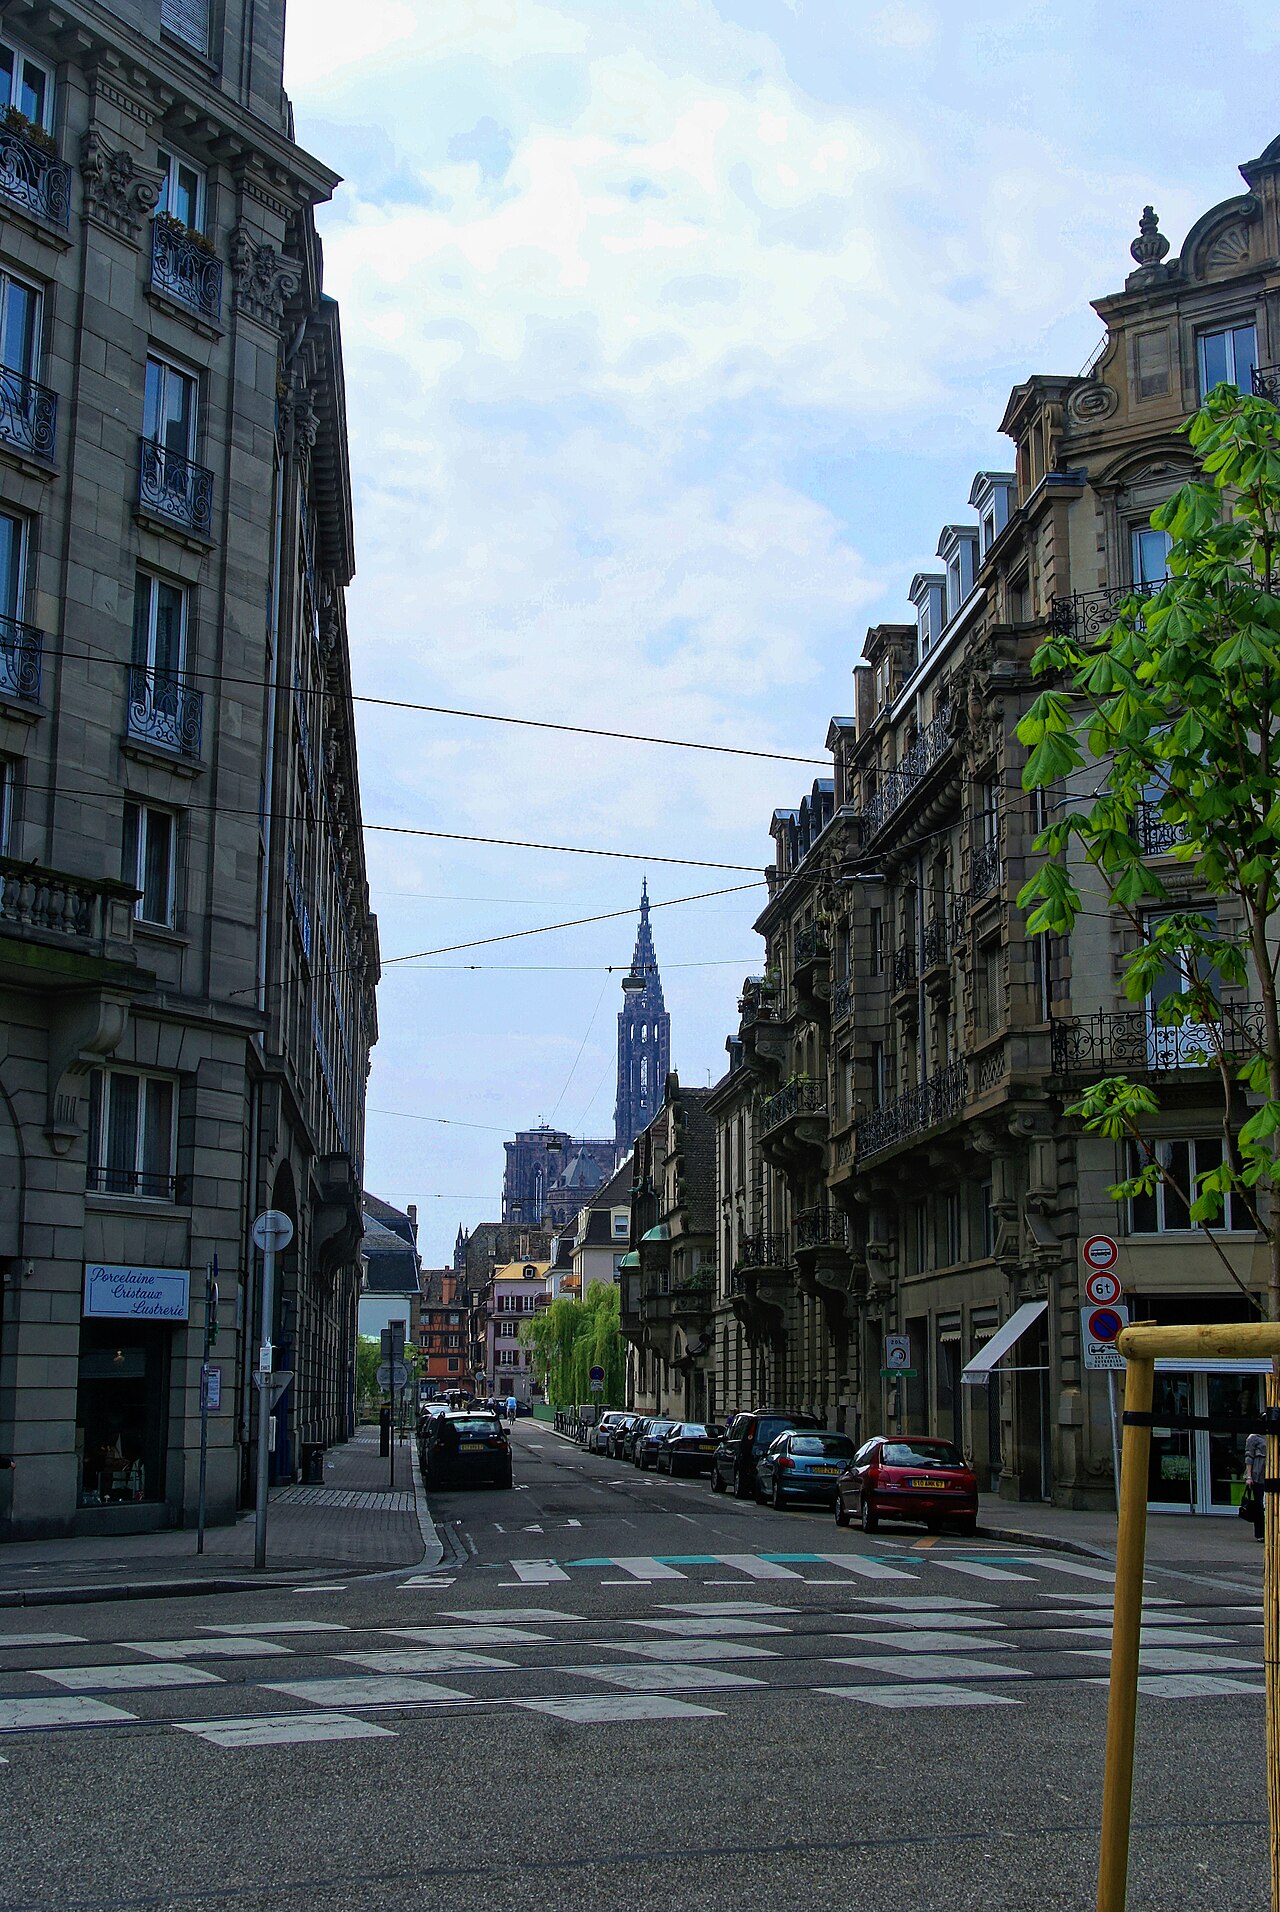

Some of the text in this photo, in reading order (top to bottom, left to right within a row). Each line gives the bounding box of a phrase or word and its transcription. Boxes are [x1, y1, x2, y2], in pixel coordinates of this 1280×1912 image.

[90, 1267, 155, 1284] Porcelaine
[111, 1284, 163, 1299] Cristaux
[1096, 1283, 1111, 1294] 6t
[130, 1300, 184, 1316] Lustrerie
